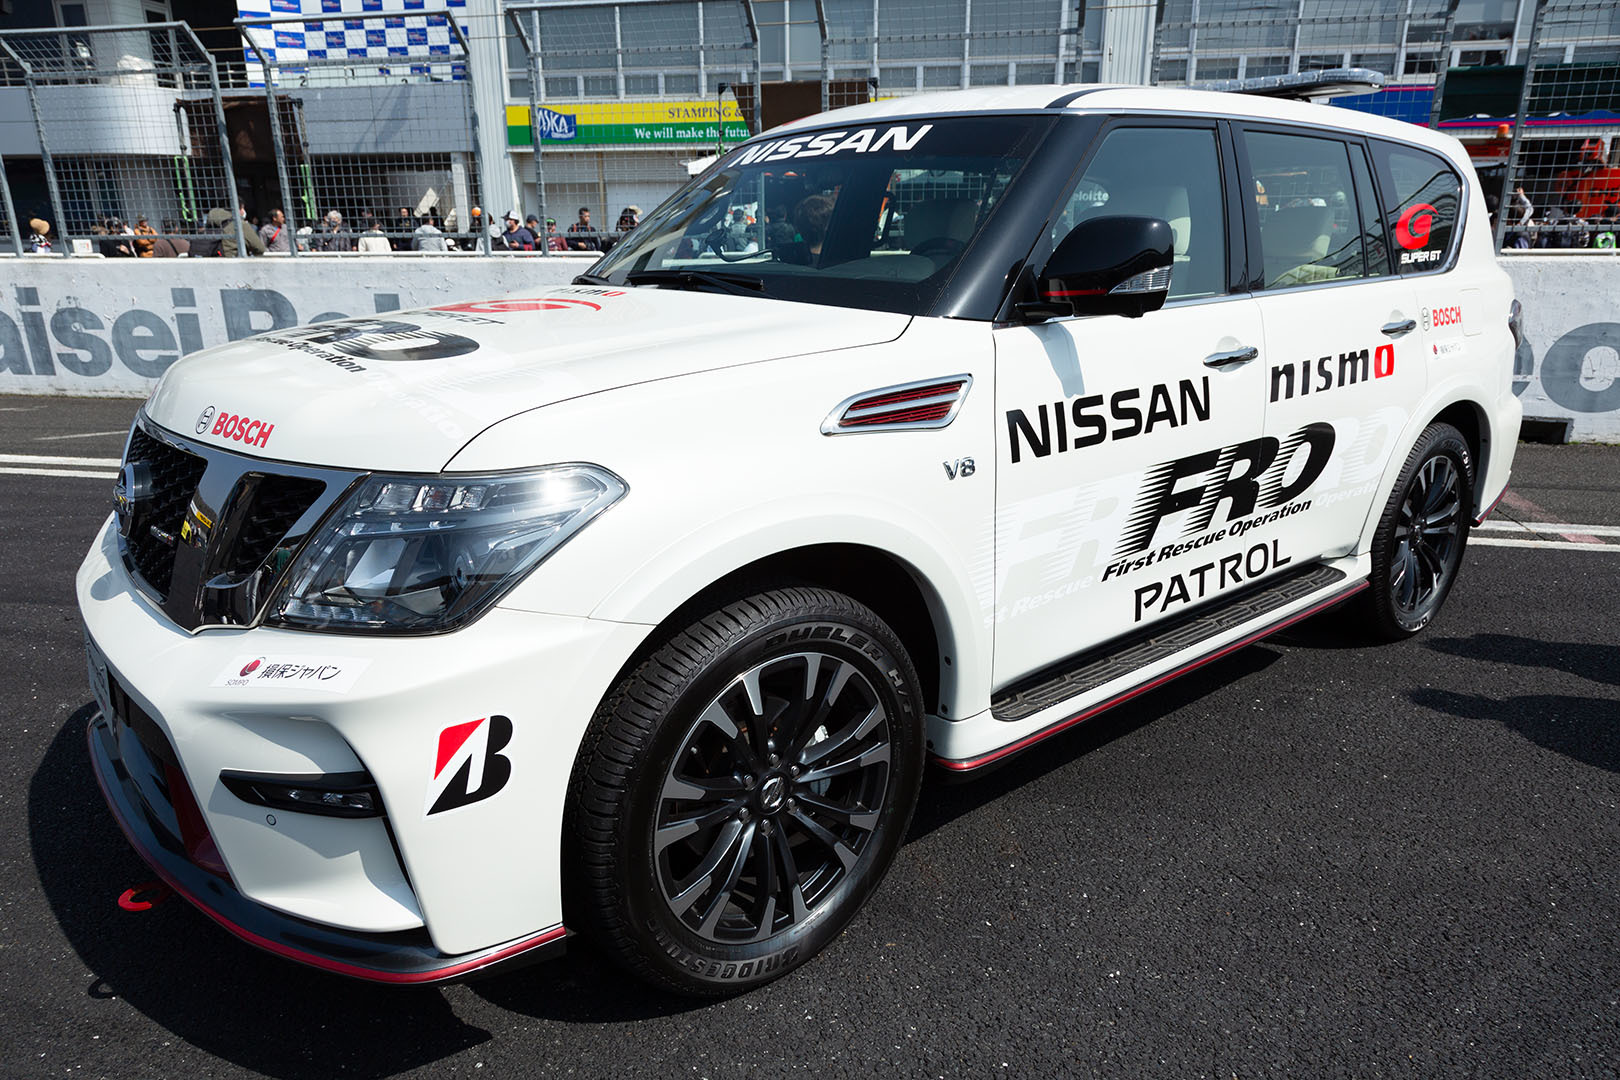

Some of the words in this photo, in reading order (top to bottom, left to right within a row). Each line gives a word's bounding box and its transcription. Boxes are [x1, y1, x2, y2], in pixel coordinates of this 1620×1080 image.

[668, 106, 732, 119] STAMPING
[634, 127, 652, 139] We
[654, 127, 674, 138] will
[676, 125, 703, 138] make
[728, 124, 934, 168] NISSAN
[1400, 251, 1429, 264] SUPER
[1429, 250, 1442, 261] GT
[1432, 306, 1462, 327] BOSCH
[1270, 343, 1395, 403] nismo
[211, 412, 275, 448] BOSCH
[1005, 376, 1211, 464] NISSAN
[942, 456, 976, 481] V8
[1111, 421, 1337, 557] FRO
[1102, 553, 1157, 582] First
[1157, 530, 1227, 562] Rescue
[1228, 499, 1313, 537] Operation
[1134, 539, 1292, 622] PATROL
[225, 678, 249, 687] SOMPO
[257, 663, 342, 681] 損保ジャパン
